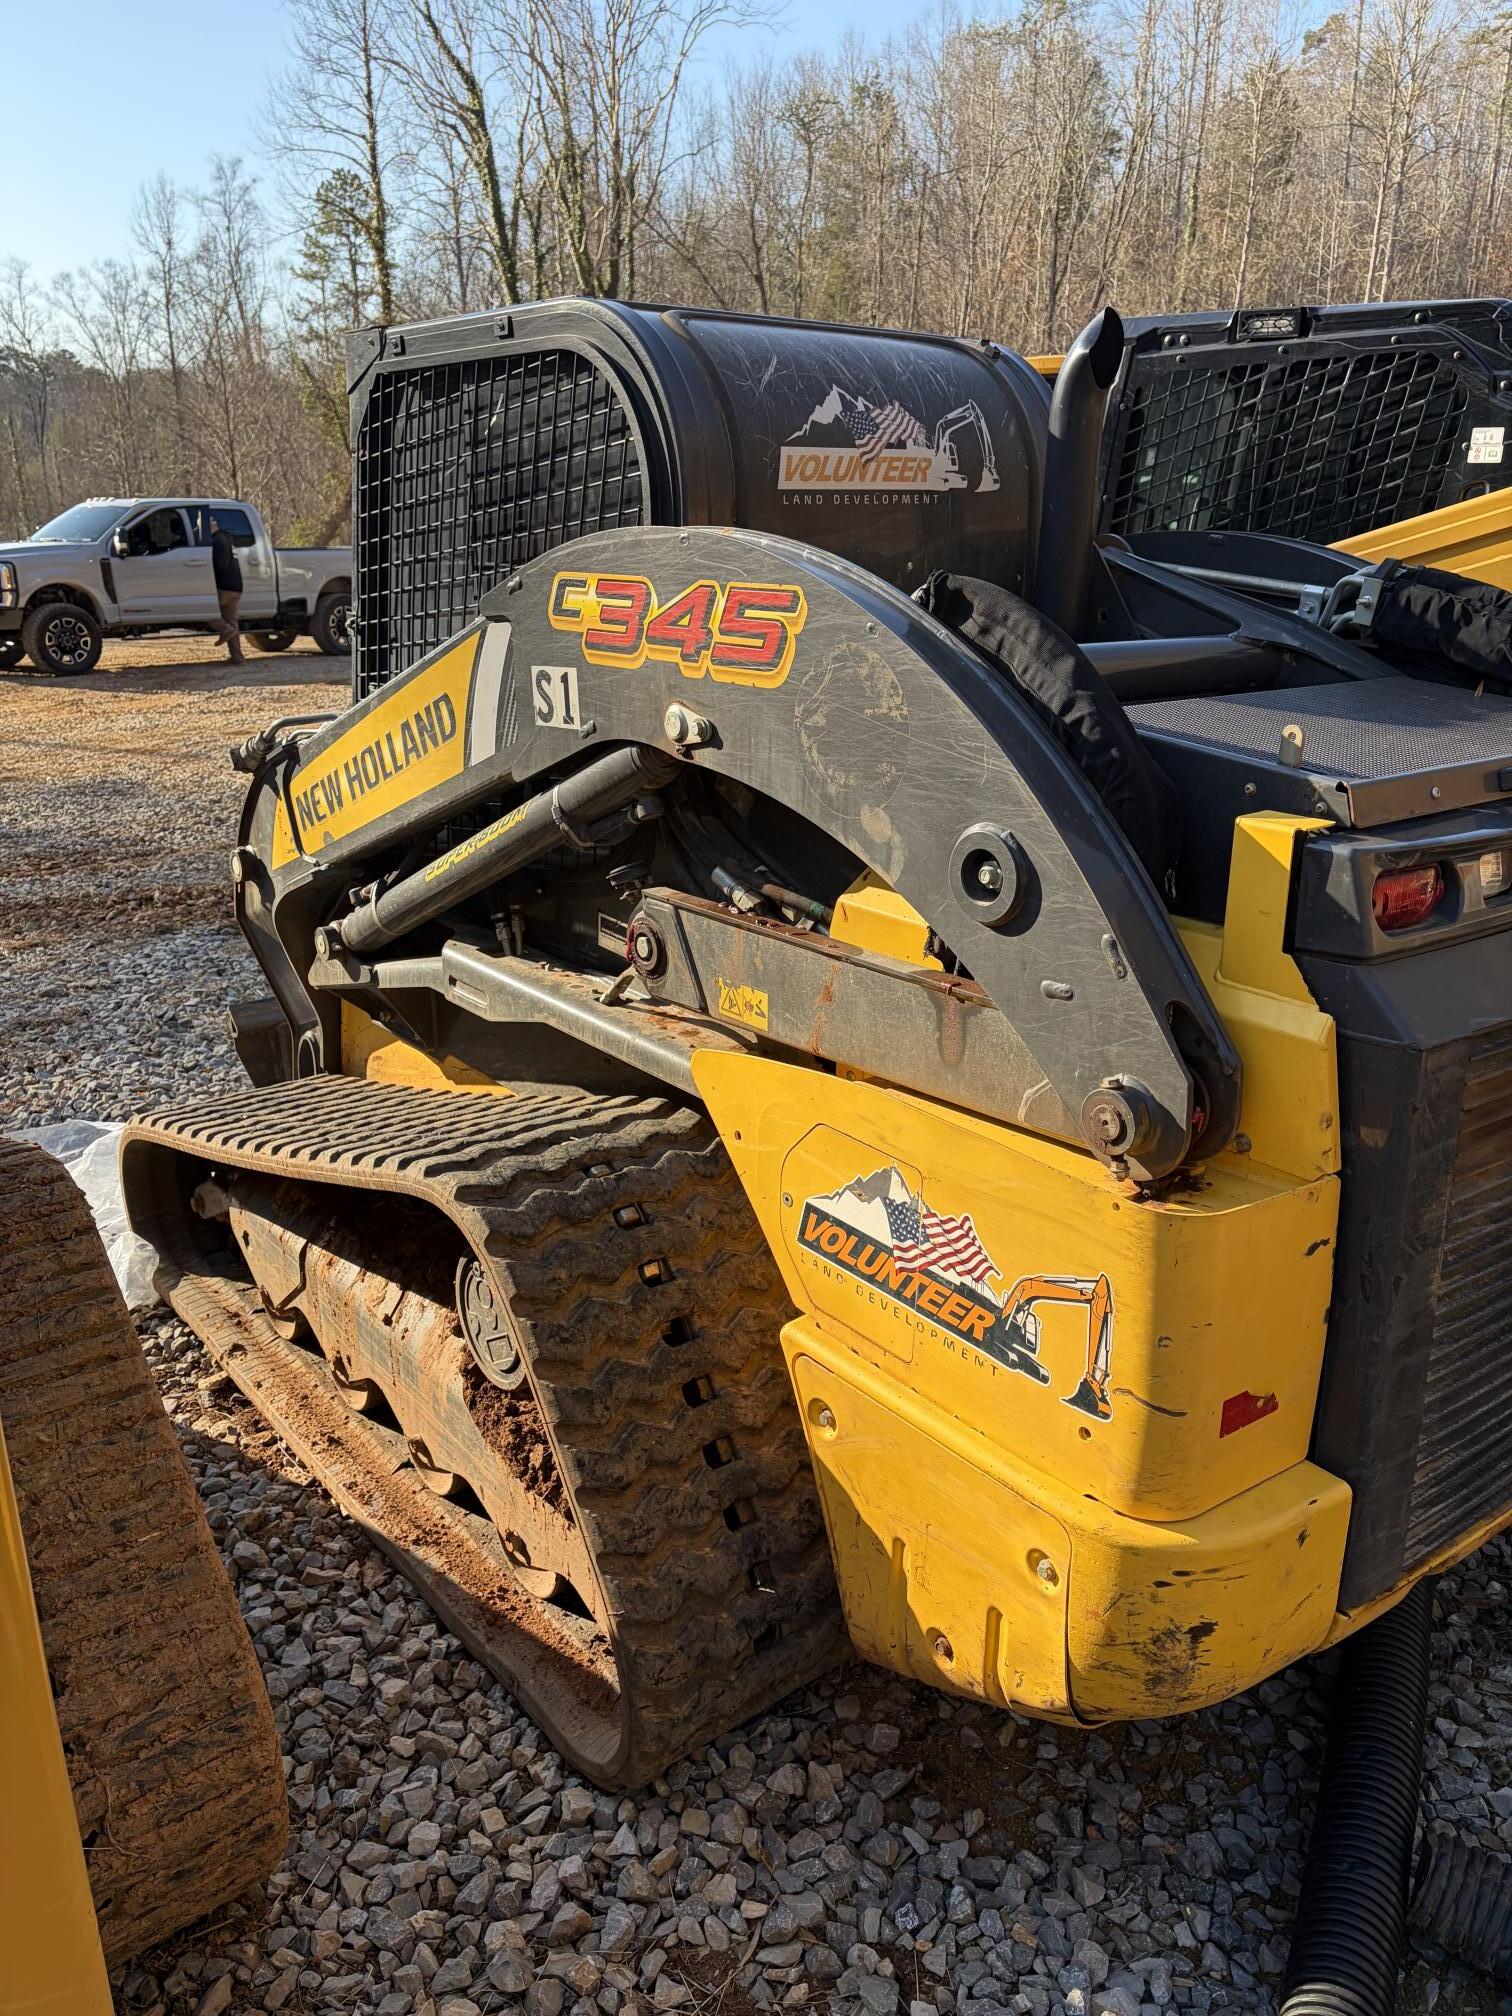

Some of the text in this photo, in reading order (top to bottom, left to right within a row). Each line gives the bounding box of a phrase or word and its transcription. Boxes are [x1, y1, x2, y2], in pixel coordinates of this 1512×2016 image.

[783, 493, 940, 505] LAND DEVELOPMENT
[784, 454, 933, 483] VOLUNTEER
[535, 668, 575, 725] S1
[294, 692, 458, 833] NEW HOLLAND
[802, 1212, 997, 1343] VOLUNTEER
[856, 1284, 1000, 1377] DEVELOPMENT
